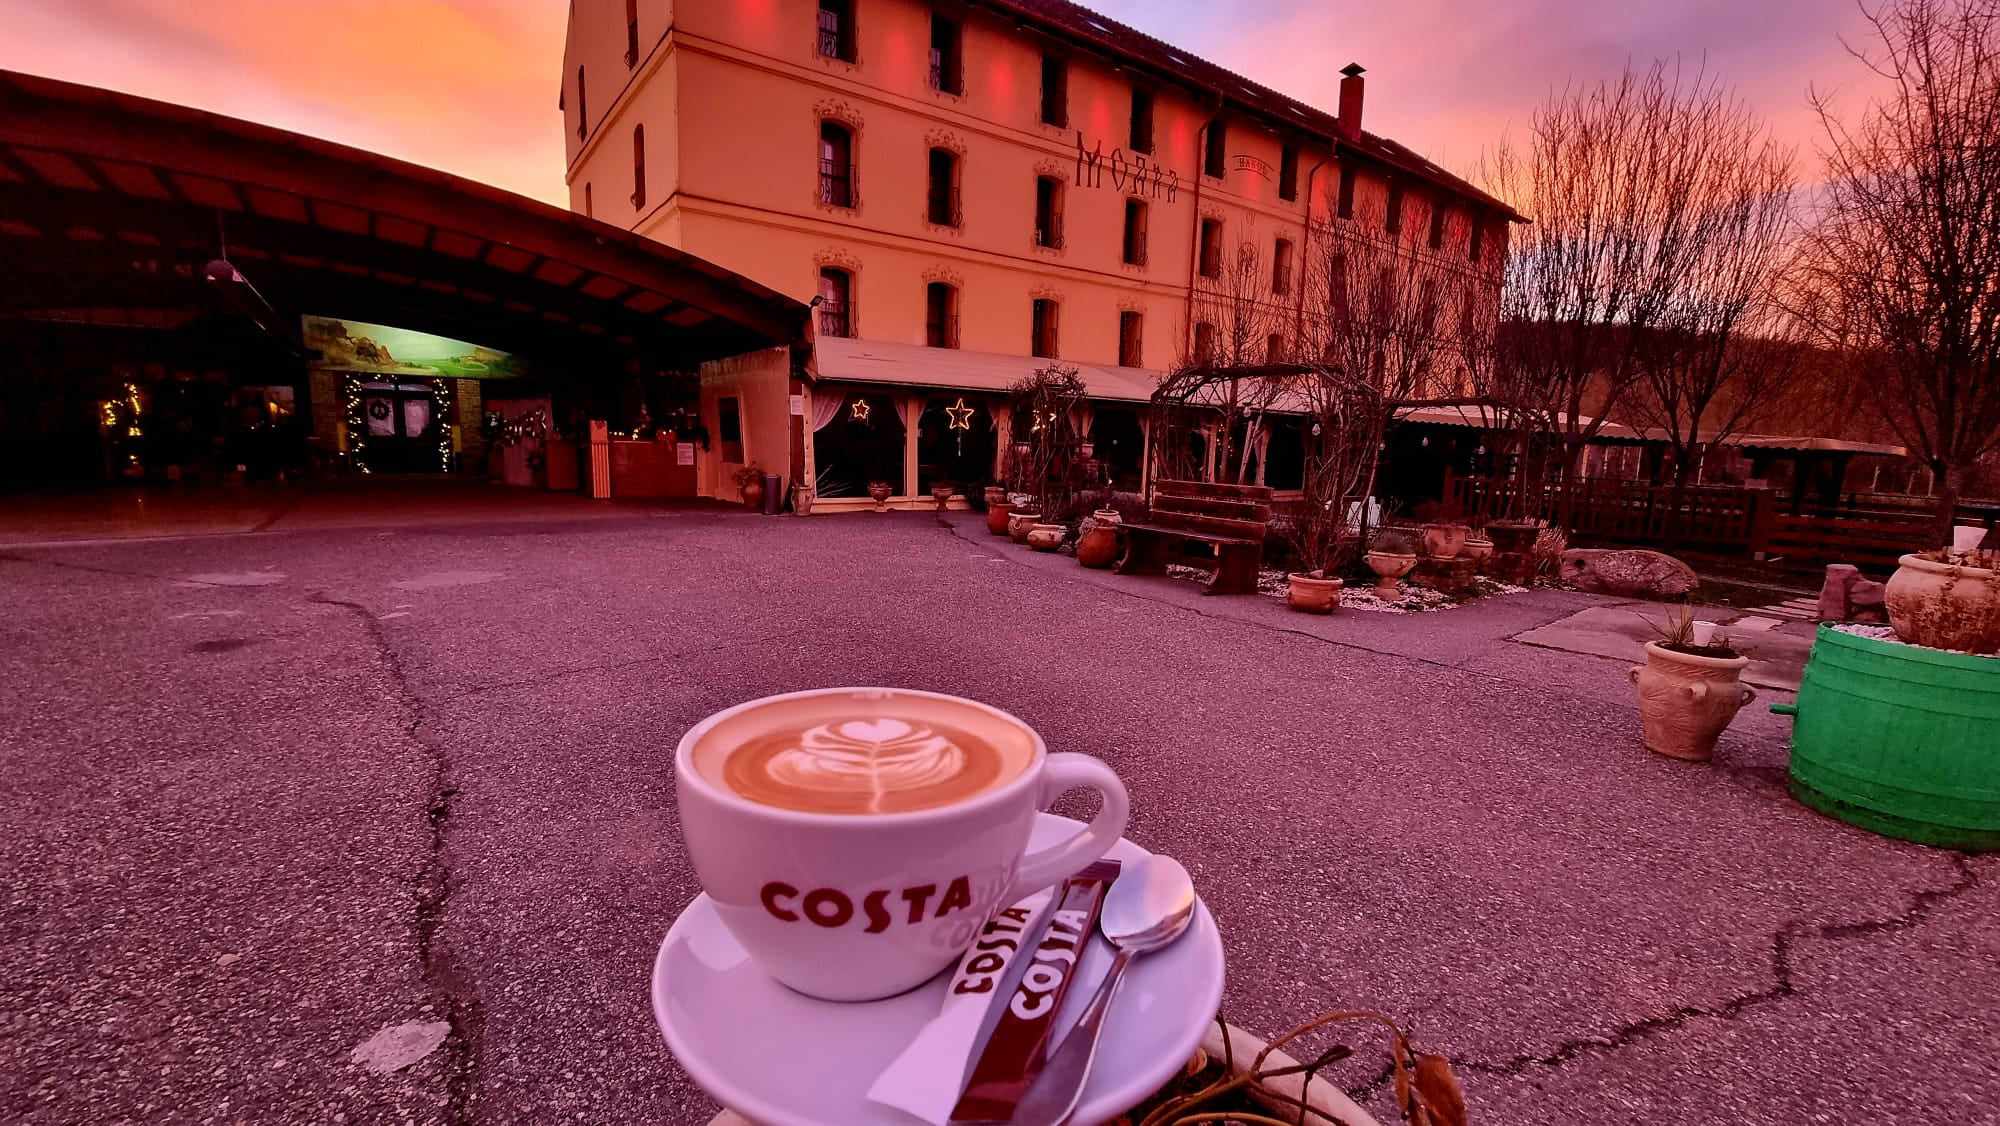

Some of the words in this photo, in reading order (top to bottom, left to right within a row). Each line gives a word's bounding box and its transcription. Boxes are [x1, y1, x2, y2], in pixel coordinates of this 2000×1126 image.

[760, 875, 972, 934] COSTA
[954, 906, 1031, 996] COSTA
[1011, 909, 1089, 1020] COSTA
